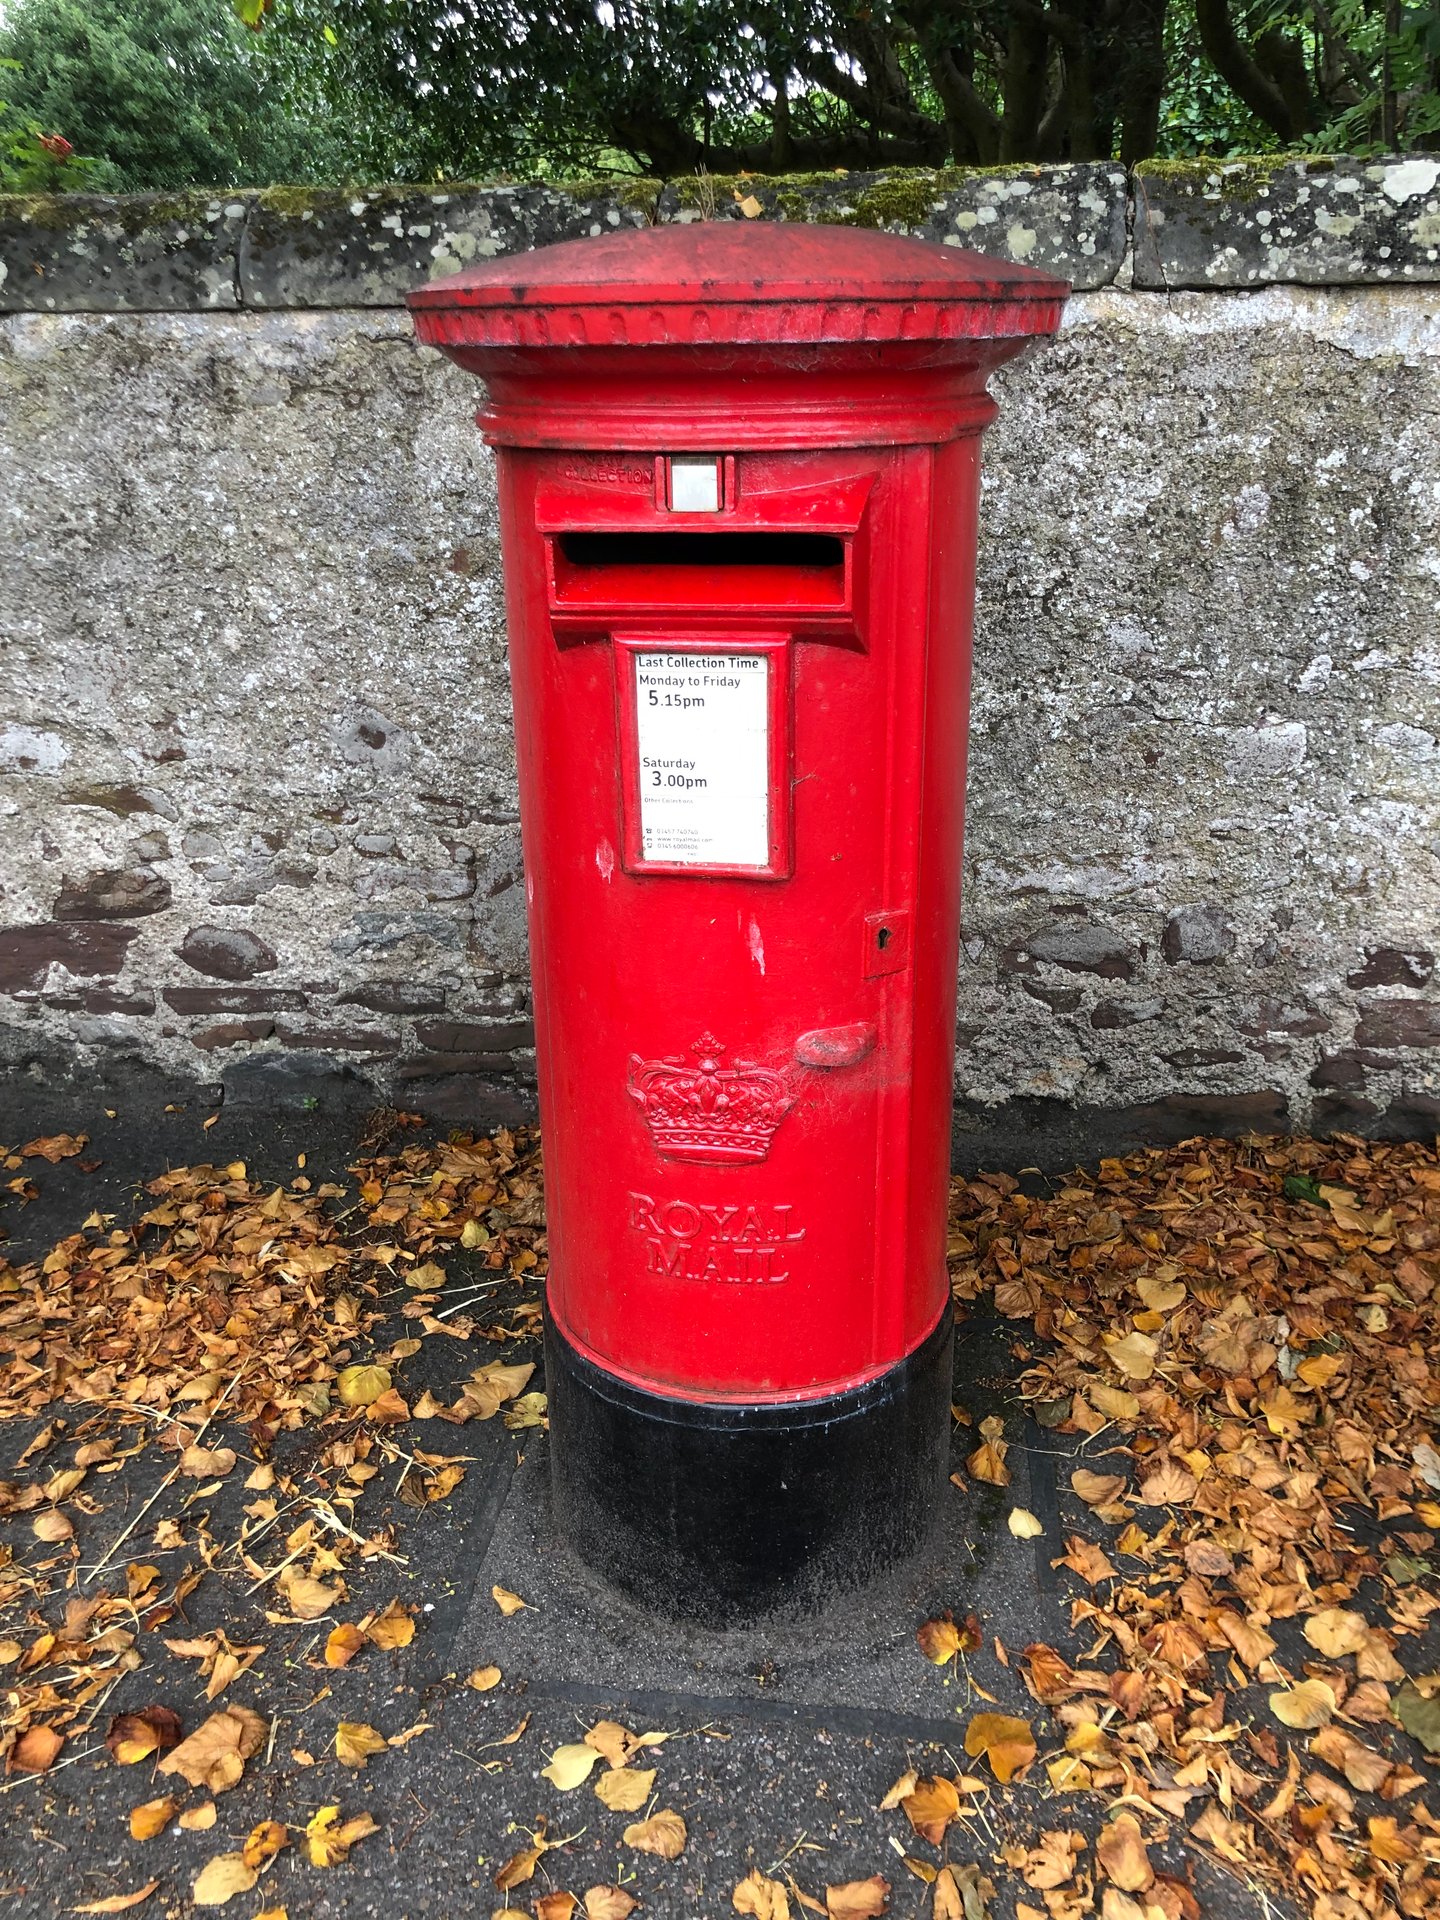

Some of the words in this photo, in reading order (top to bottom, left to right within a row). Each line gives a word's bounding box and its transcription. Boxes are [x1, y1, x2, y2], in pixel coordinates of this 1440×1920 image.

[638, 656, 664, 668] Last
[667, 656, 725, 669] Collection
[728, 657, 759, 669] Time
[639, 674, 685, 688] Monday
[688, 676, 700, 686] to
[703, 675, 741, 689] Friday
[649, 689, 705, 709] 5.15pm
[642, 756, 696, 771] Saturday
[652, 770, 708, 790] 3.00pm
[627, 1190, 807, 1244] ROYAL
[647, 1236, 790, 1285] MAIL
